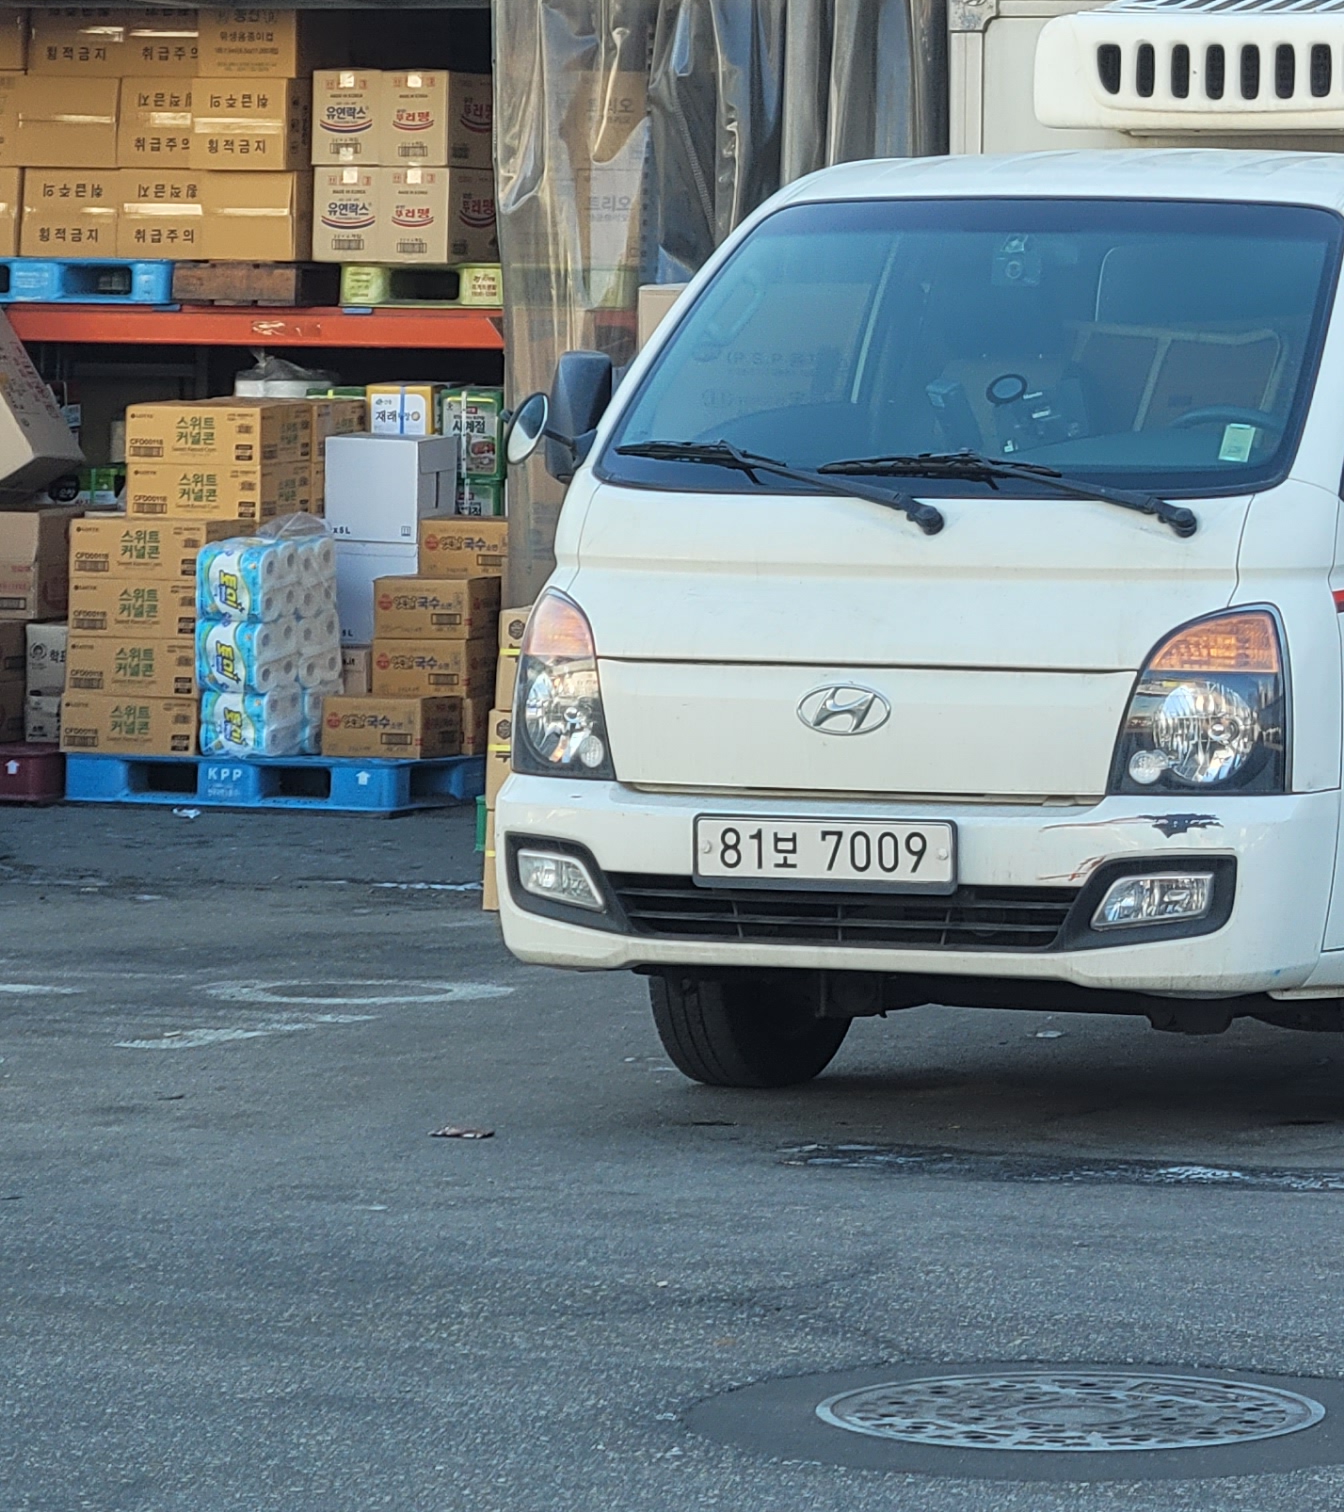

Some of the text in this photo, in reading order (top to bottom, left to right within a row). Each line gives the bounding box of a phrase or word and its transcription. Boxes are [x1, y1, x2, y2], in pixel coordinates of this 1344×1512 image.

[134, 228, 195, 244] 취급주의
[175, 415, 216, 431] 스위트
[375, 409, 411, 423] 재래장
[175, 431, 216, 446] 커널콘
[178, 473, 218, 487] 스위트
[178, 488, 218, 502] 커널콘
[120, 529, 161, 544] 스위트
[120, 545, 161, 559] 커널콘
[118, 588, 159, 602] 스위트
[118, 603, 159, 618] 커널콘
[115, 647, 154, 661] 스위트
[115, 663, 154, 677] 커널콘
[110, 705, 151, 719] 스위트
[110, 720, 150, 735] 커널콘
[207, 767, 242, 781] KPP
[719, 826, 928, 874] 81보 7009
